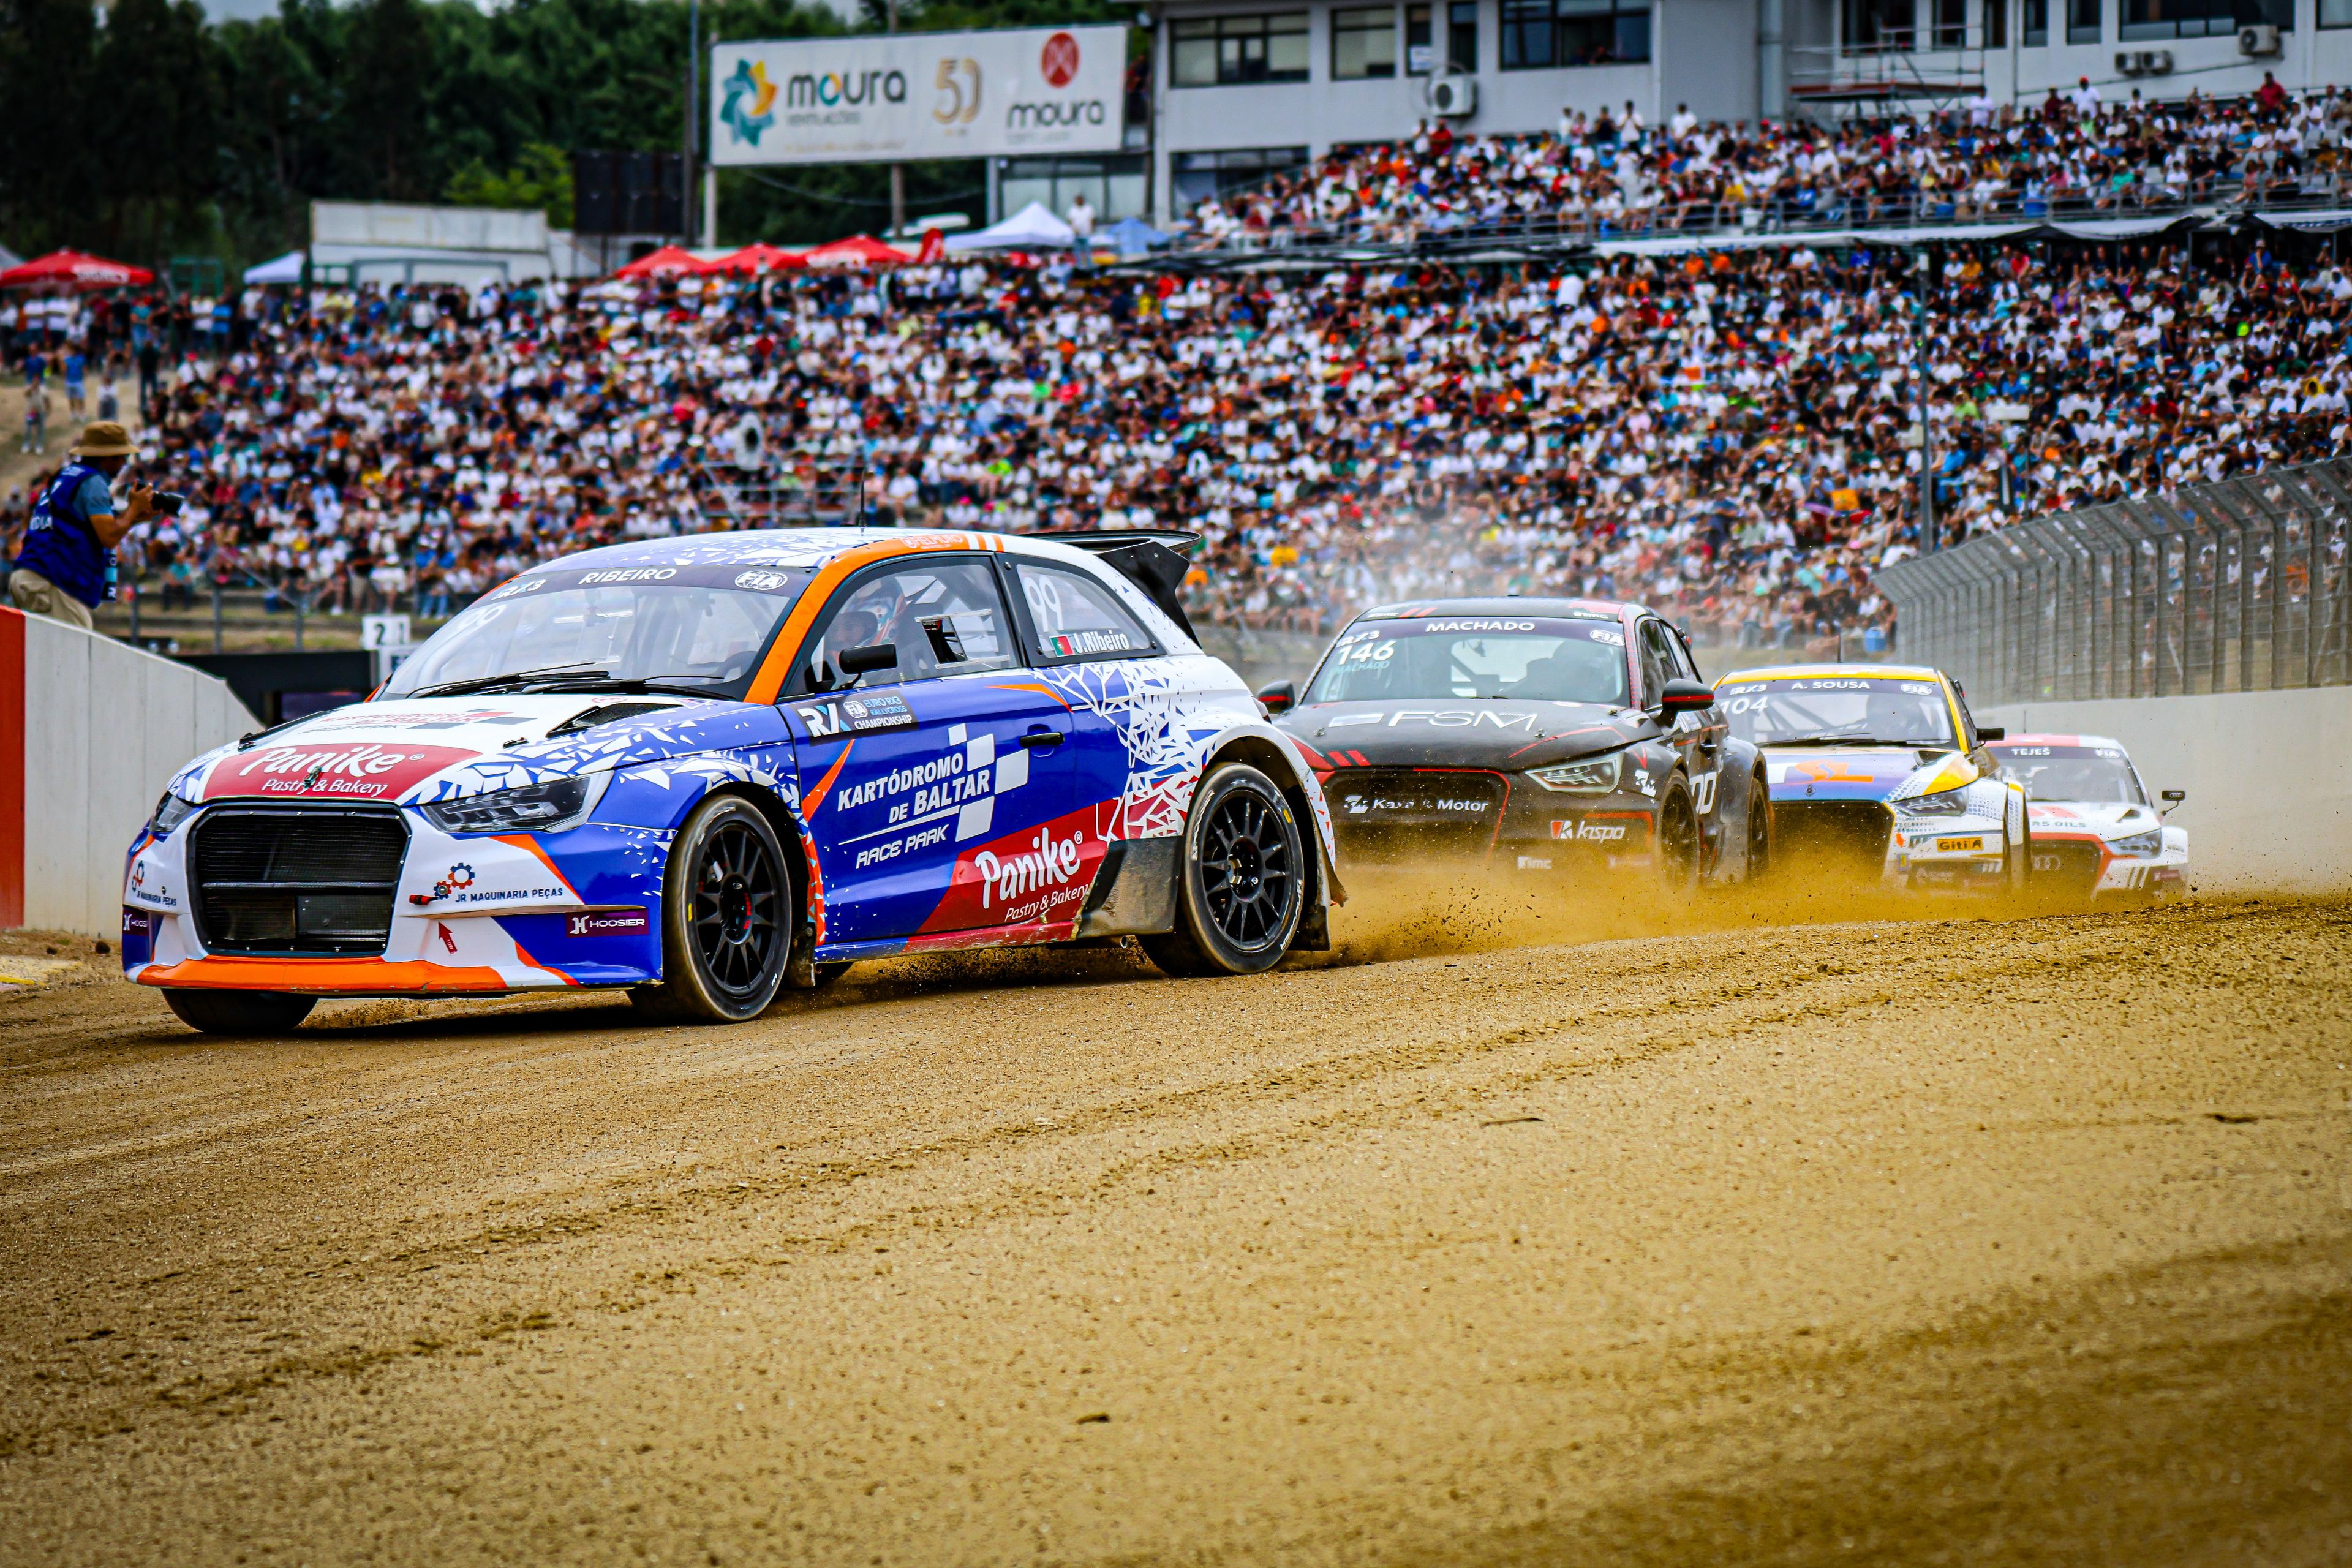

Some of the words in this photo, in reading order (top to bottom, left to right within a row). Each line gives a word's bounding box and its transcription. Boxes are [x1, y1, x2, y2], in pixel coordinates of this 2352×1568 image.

[788, 70, 907, 108] moura
[1006, 100, 1104, 128] moura
[578, 568, 677, 584] RIBEIRO
[1023, 575, 1064, 632] 99
[1425, 621, 1536, 633] MACHADO
[1072, 630, 1130, 654] J.Ribeiro
[1593, 631, 1624, 644] FIA
[1338, 640, 1396, 665] 146
[1812, 680, 1870, 690] SOUSA
[862, 698, 886, 708] EURO
[886, 696, 903, 705] RX3
[869, 706, 908, 716] RALLYCROSS
[1720, 696, 1768, 715] 104
[854, 714, 913, 730] CHAMPIONSHIP
[1388, 710, 1538, 731] FSM
[2011, 747, 2051, 756] TEJEŠ
[239, 745, 405, 777] Panike
[261, 779, 314, 795] Pastry
[313, 780, 325, 792] &
[328, 780, 388, 797] Bakery
[837, 753, 964, 812] KARTÓDROMO
[888, 802, 909, 824] DE
[913, 769, 990, 816] BALTAR
[1437, 799, 1490, 812] Motor
[856, 840, 902, 869] RACE
[905, 824, 949, 853] PARK
[1939, 840, 1967, 850] Giti
[974, 827, 1080, 909] Panike
[455, 894, 467, 903] JR
[470, 889, 528, 902] MAQUINARIA
[532, 888, 564, 899] PEÇAS
[1005, 902, 1039, 922] Pastry
[1039, 895, 1049, 911] &
[1050, 884, 1088, 908] Bakery
[589, 919, 645, 927] HOOSIER
